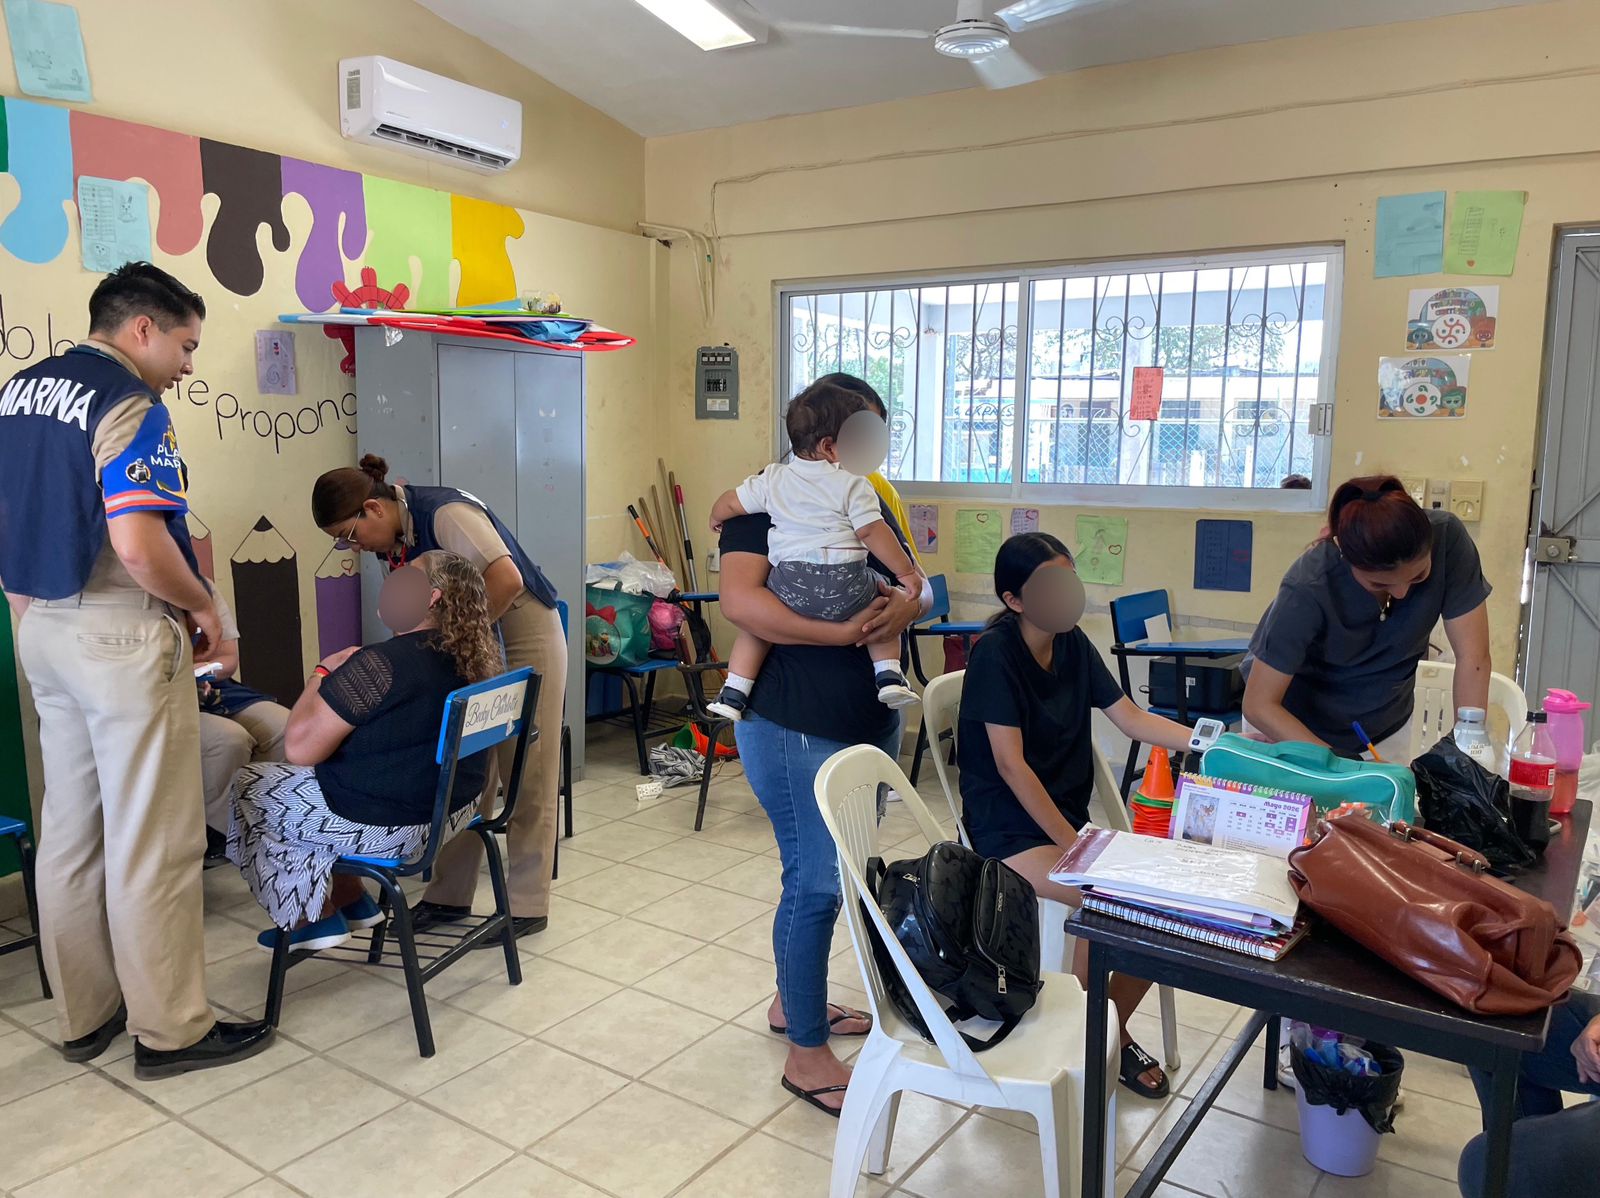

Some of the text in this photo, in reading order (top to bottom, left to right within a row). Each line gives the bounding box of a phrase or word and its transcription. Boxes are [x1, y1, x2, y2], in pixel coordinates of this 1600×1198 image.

[0, 377, 96, 431] MARINA
[1263, 801, 1282, 810] Mayo
[1282, 804, 1300, 814] 2026
